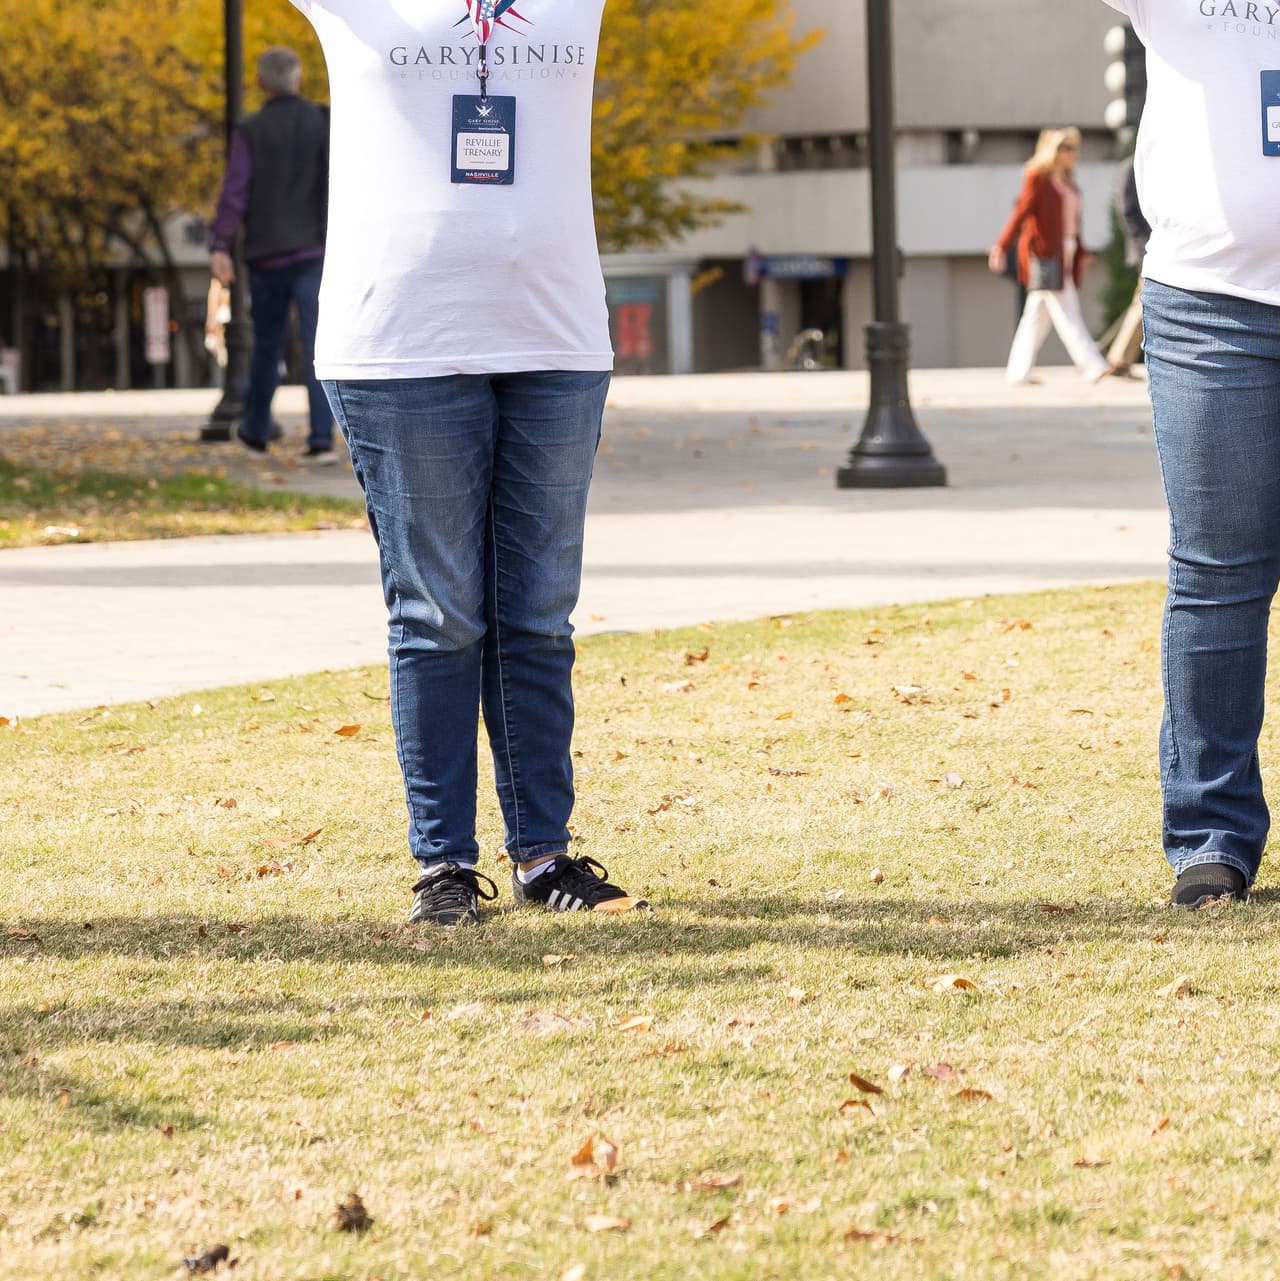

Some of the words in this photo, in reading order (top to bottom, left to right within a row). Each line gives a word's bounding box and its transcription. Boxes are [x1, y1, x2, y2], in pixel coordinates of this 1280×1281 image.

[389, 45, 477, 66] GARY
[494, 44, 585, 66] SINISE
[463, 148, 503, 157] TRENARY
